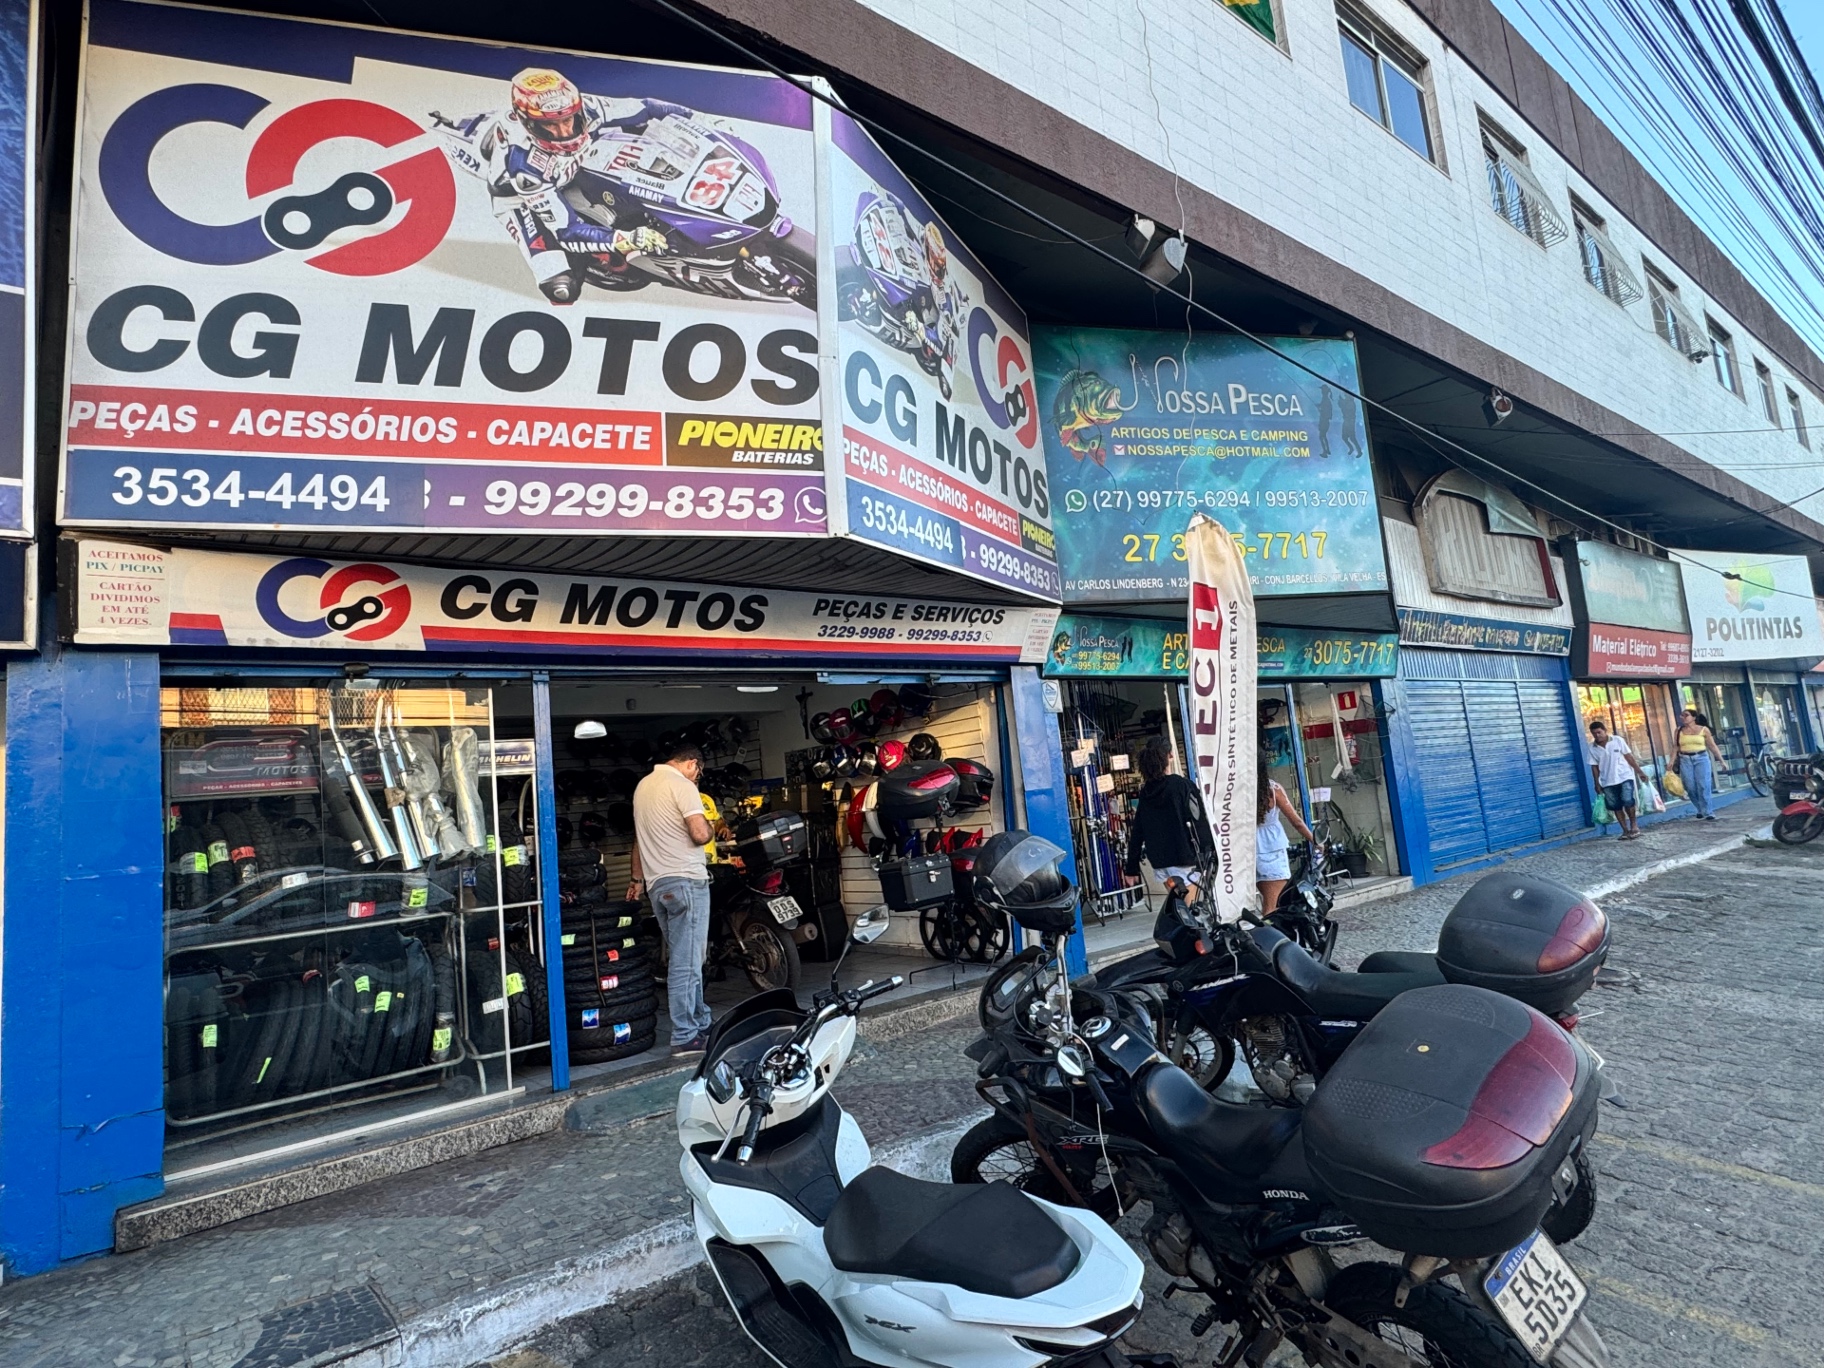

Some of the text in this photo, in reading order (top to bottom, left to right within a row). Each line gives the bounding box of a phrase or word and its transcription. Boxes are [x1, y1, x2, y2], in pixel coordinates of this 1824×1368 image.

[87, 284, 820, 406] CG MOTOS
[1228, 383, 1304, 417] PESCA
[68, 400, 198, 438] PEÇAS
[229, 406, 458, 444] ACESSÓRIOS
[486, 418, 653, 451] CAPACETE
[845, 350, 1049, 520] CG MOTOS
[1110, 426, 1308, 442] ARTIGOS DE PESCA E CAMPING
[731, 451, 815, 466] BATERIAS
[1127, 444, 1311, 458] NOSSAPESCA@HOTMAIL.COM
[112, 465, 390, 512] 3534-4494
[843, 436, 889, 477] PEÇAS
[898, 463, 969, 512] ACESSÓRIOS
[975, 501, 1018, 537] CAPACETE
[483, 480, 785, 521] 99299-8353
[1092, 490, 1132, 512] (27)
[1140, 490, 1251, 508] 99775-6294
[1266, 489, 1369, 508] 99513-2007
[861, 496, 954, 554] 3534-4494
[88, 550, 164, 562] ACEITAMOS
[1122, 534, 1161, 562] 27
[86, 561, 109, 571] PIX
[119, 563, 165, 574] PICPAY
[980, 543, 1051, 592] 99299-8353
[90, 592, 161, 603] DIVIDIMOS
[99, 581, 152, 592] CARTÃO
[1065, 581, 1076, 591] AV
[1077, 579, 1111, 590] CARLOS
[1112, 578, 1164, 589] LINDENBERG
[1171, 578, 1177, 588] N
[102, 604, 149, 615] EM ATÉ
[440, 574, 769, 633] CG MOTOS
[812, 598, 890, 624] PEÇAS
[891, 603, 908, 620] E
[910, 604, 1006, 629] SERVIÇOS
[110, 616, 152, 626] VEZES.
[817, 624, 895, 640] 3229-9988
[906, 627, 982, 643] 99299-8353
[1706, 615, 1804, 642] POLITINTAS
[1313, 639, 1394, 665] 3075-7717
[1592, 634, 1627, 656] Material
[1629, 638, 1657, 658] Elétrico
[1220, 600, 1238, 895] CONDICIONADOR SINTÉTICO DE METAIS
[256, 764, 309, 776] MOTOS
[777, 907, 801, 922] 9739
[1262, 1189, 1310, 1200] HONDA
[1504, 1246, 1527, 1276] BRASIL
[1508, 1250, 1553, 1311] EKI
[1523, 1269, 1576, 1345] 5D35
